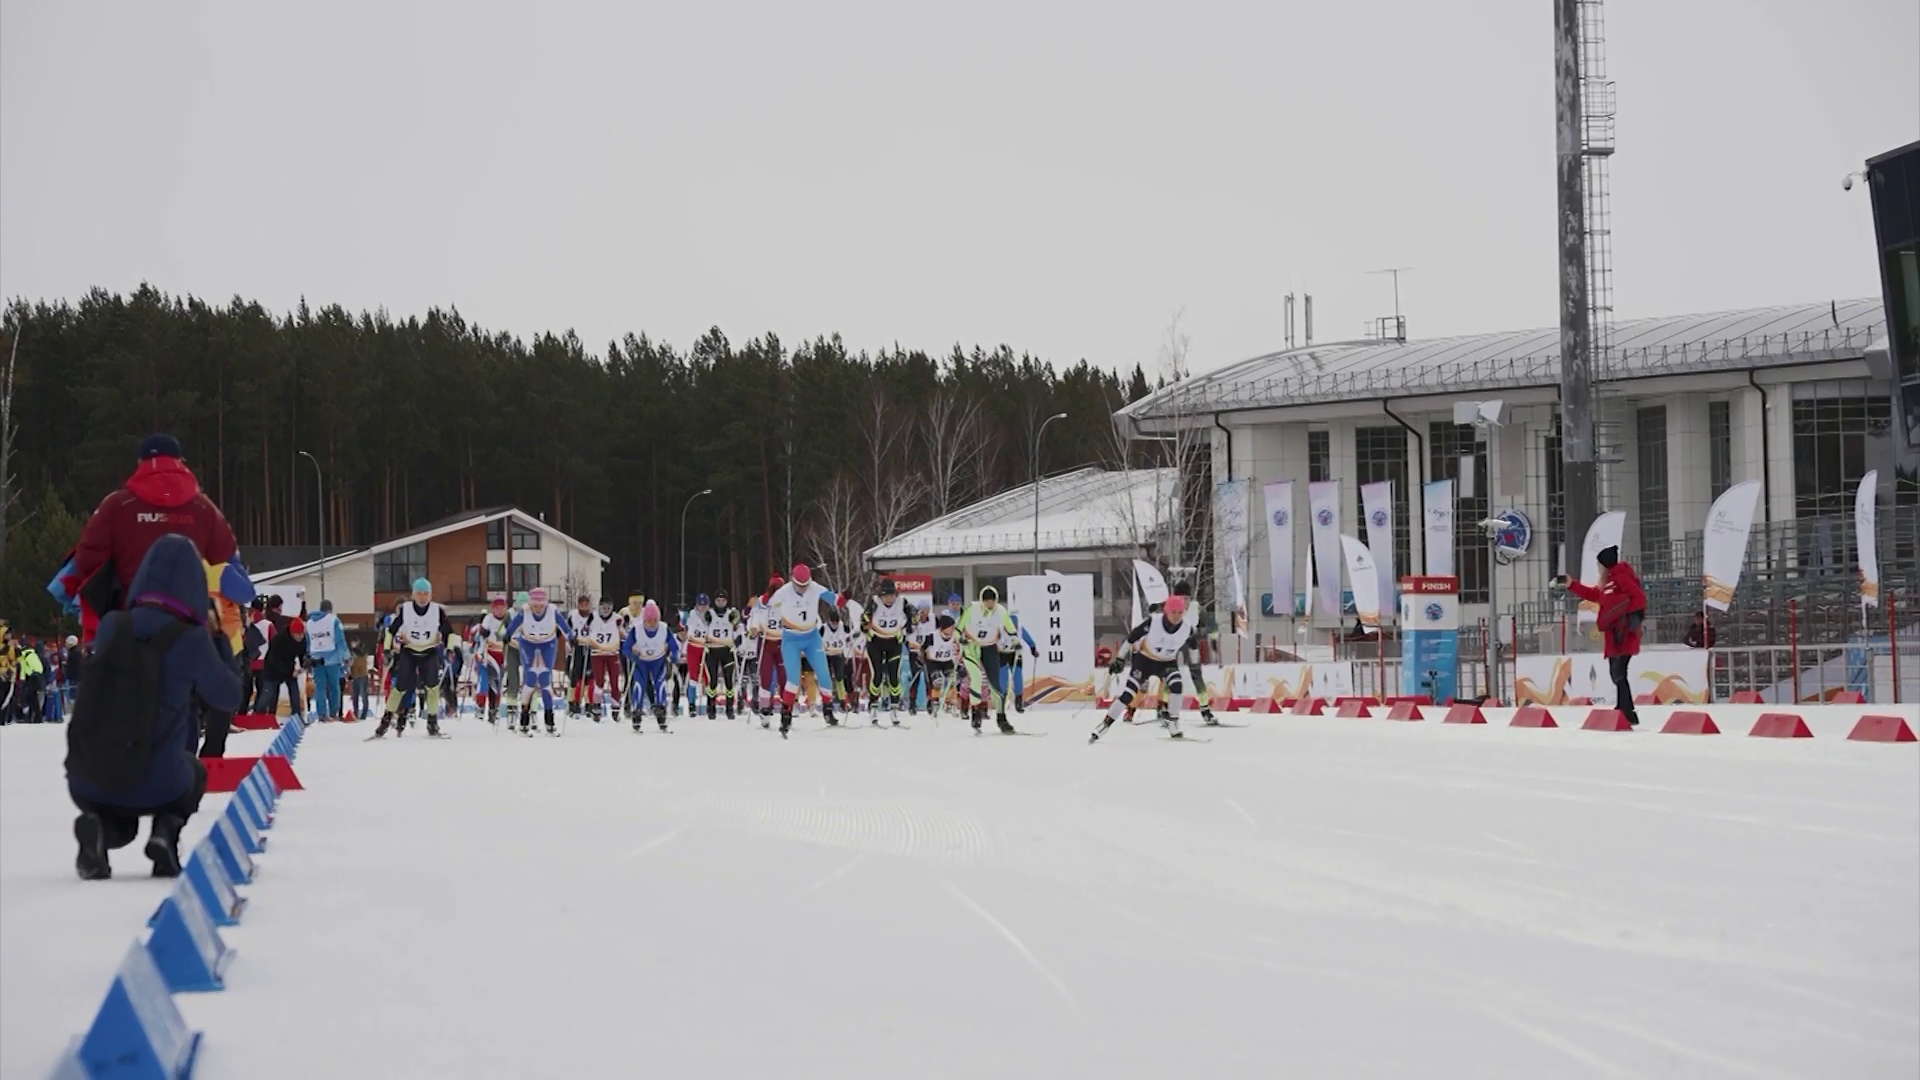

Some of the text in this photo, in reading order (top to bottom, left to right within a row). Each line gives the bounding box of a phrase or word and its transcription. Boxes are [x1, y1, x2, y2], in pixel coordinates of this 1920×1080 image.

[894, 581, 925, 590] FINISH
[1047, 583, 1063, 663] ФИНИШ
[596, 633, 612, 644] 37
